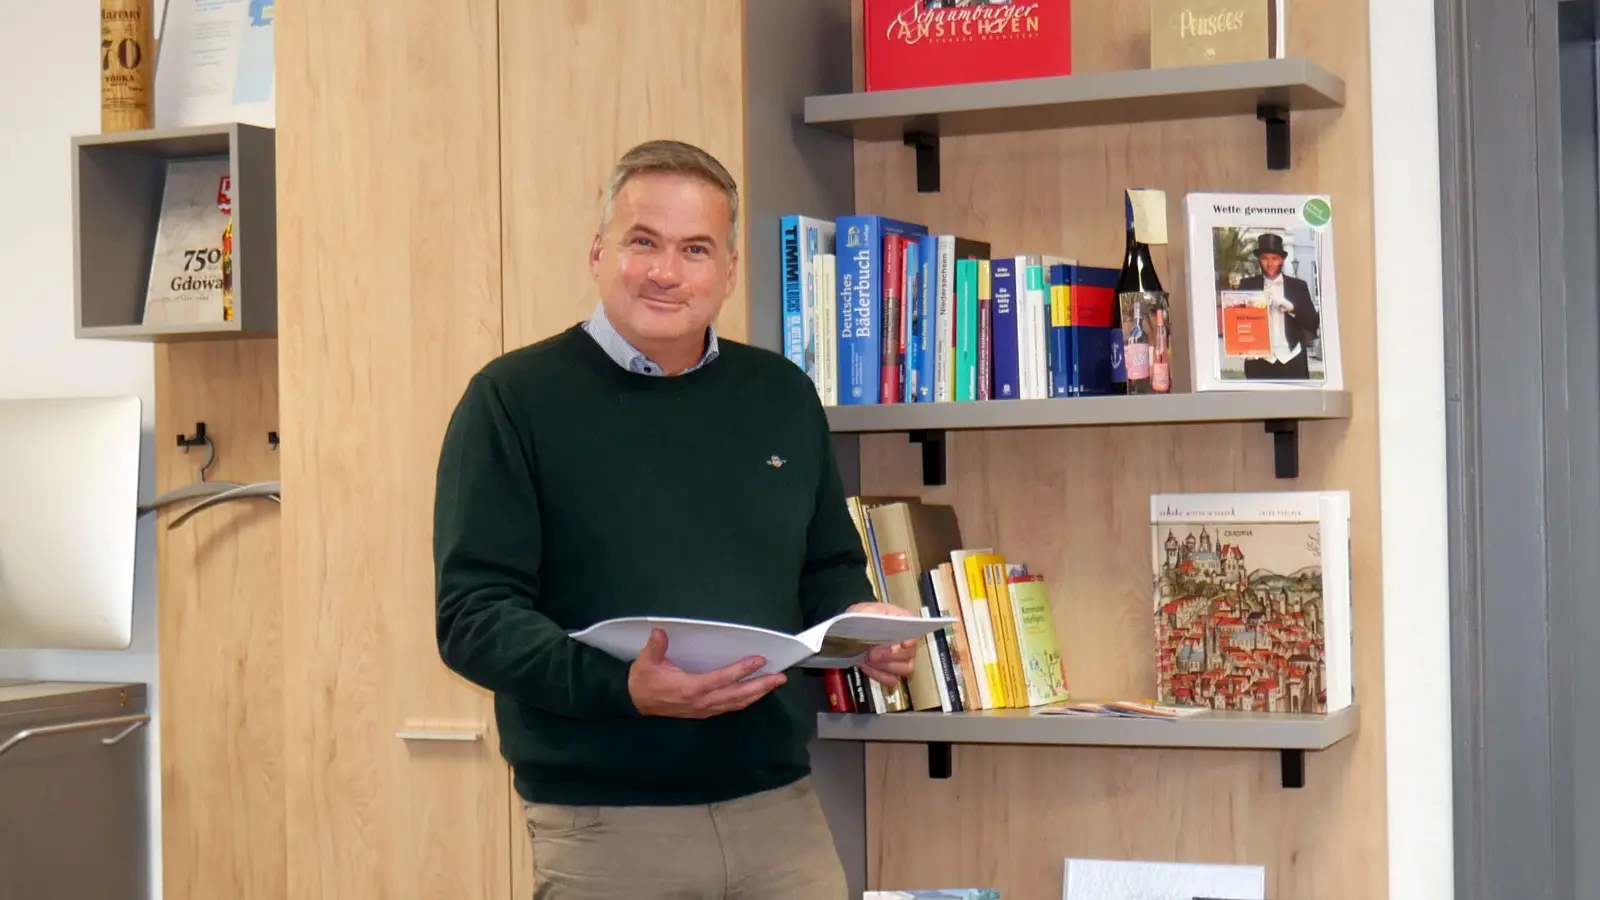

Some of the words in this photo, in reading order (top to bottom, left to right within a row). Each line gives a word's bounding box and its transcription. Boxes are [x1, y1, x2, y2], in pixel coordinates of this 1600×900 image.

[897, 17, 1039, 39] ANSICHTEN
[1180, 8, 1244, 39] Pensées
[1213, 204, 1241, 215] Wette
[1244, 206, 1296, 216] gewonnen
[184, 248, 221, 272] 750
[784, 224, 798, 282] TIMM
[171, 277, 223, 291] Gdowa
[854, 250, 870, 338] Bäderbuch
[939, 253, 948, 315] Niedersachsen
[842, 274, 852, 338] Deutsches
